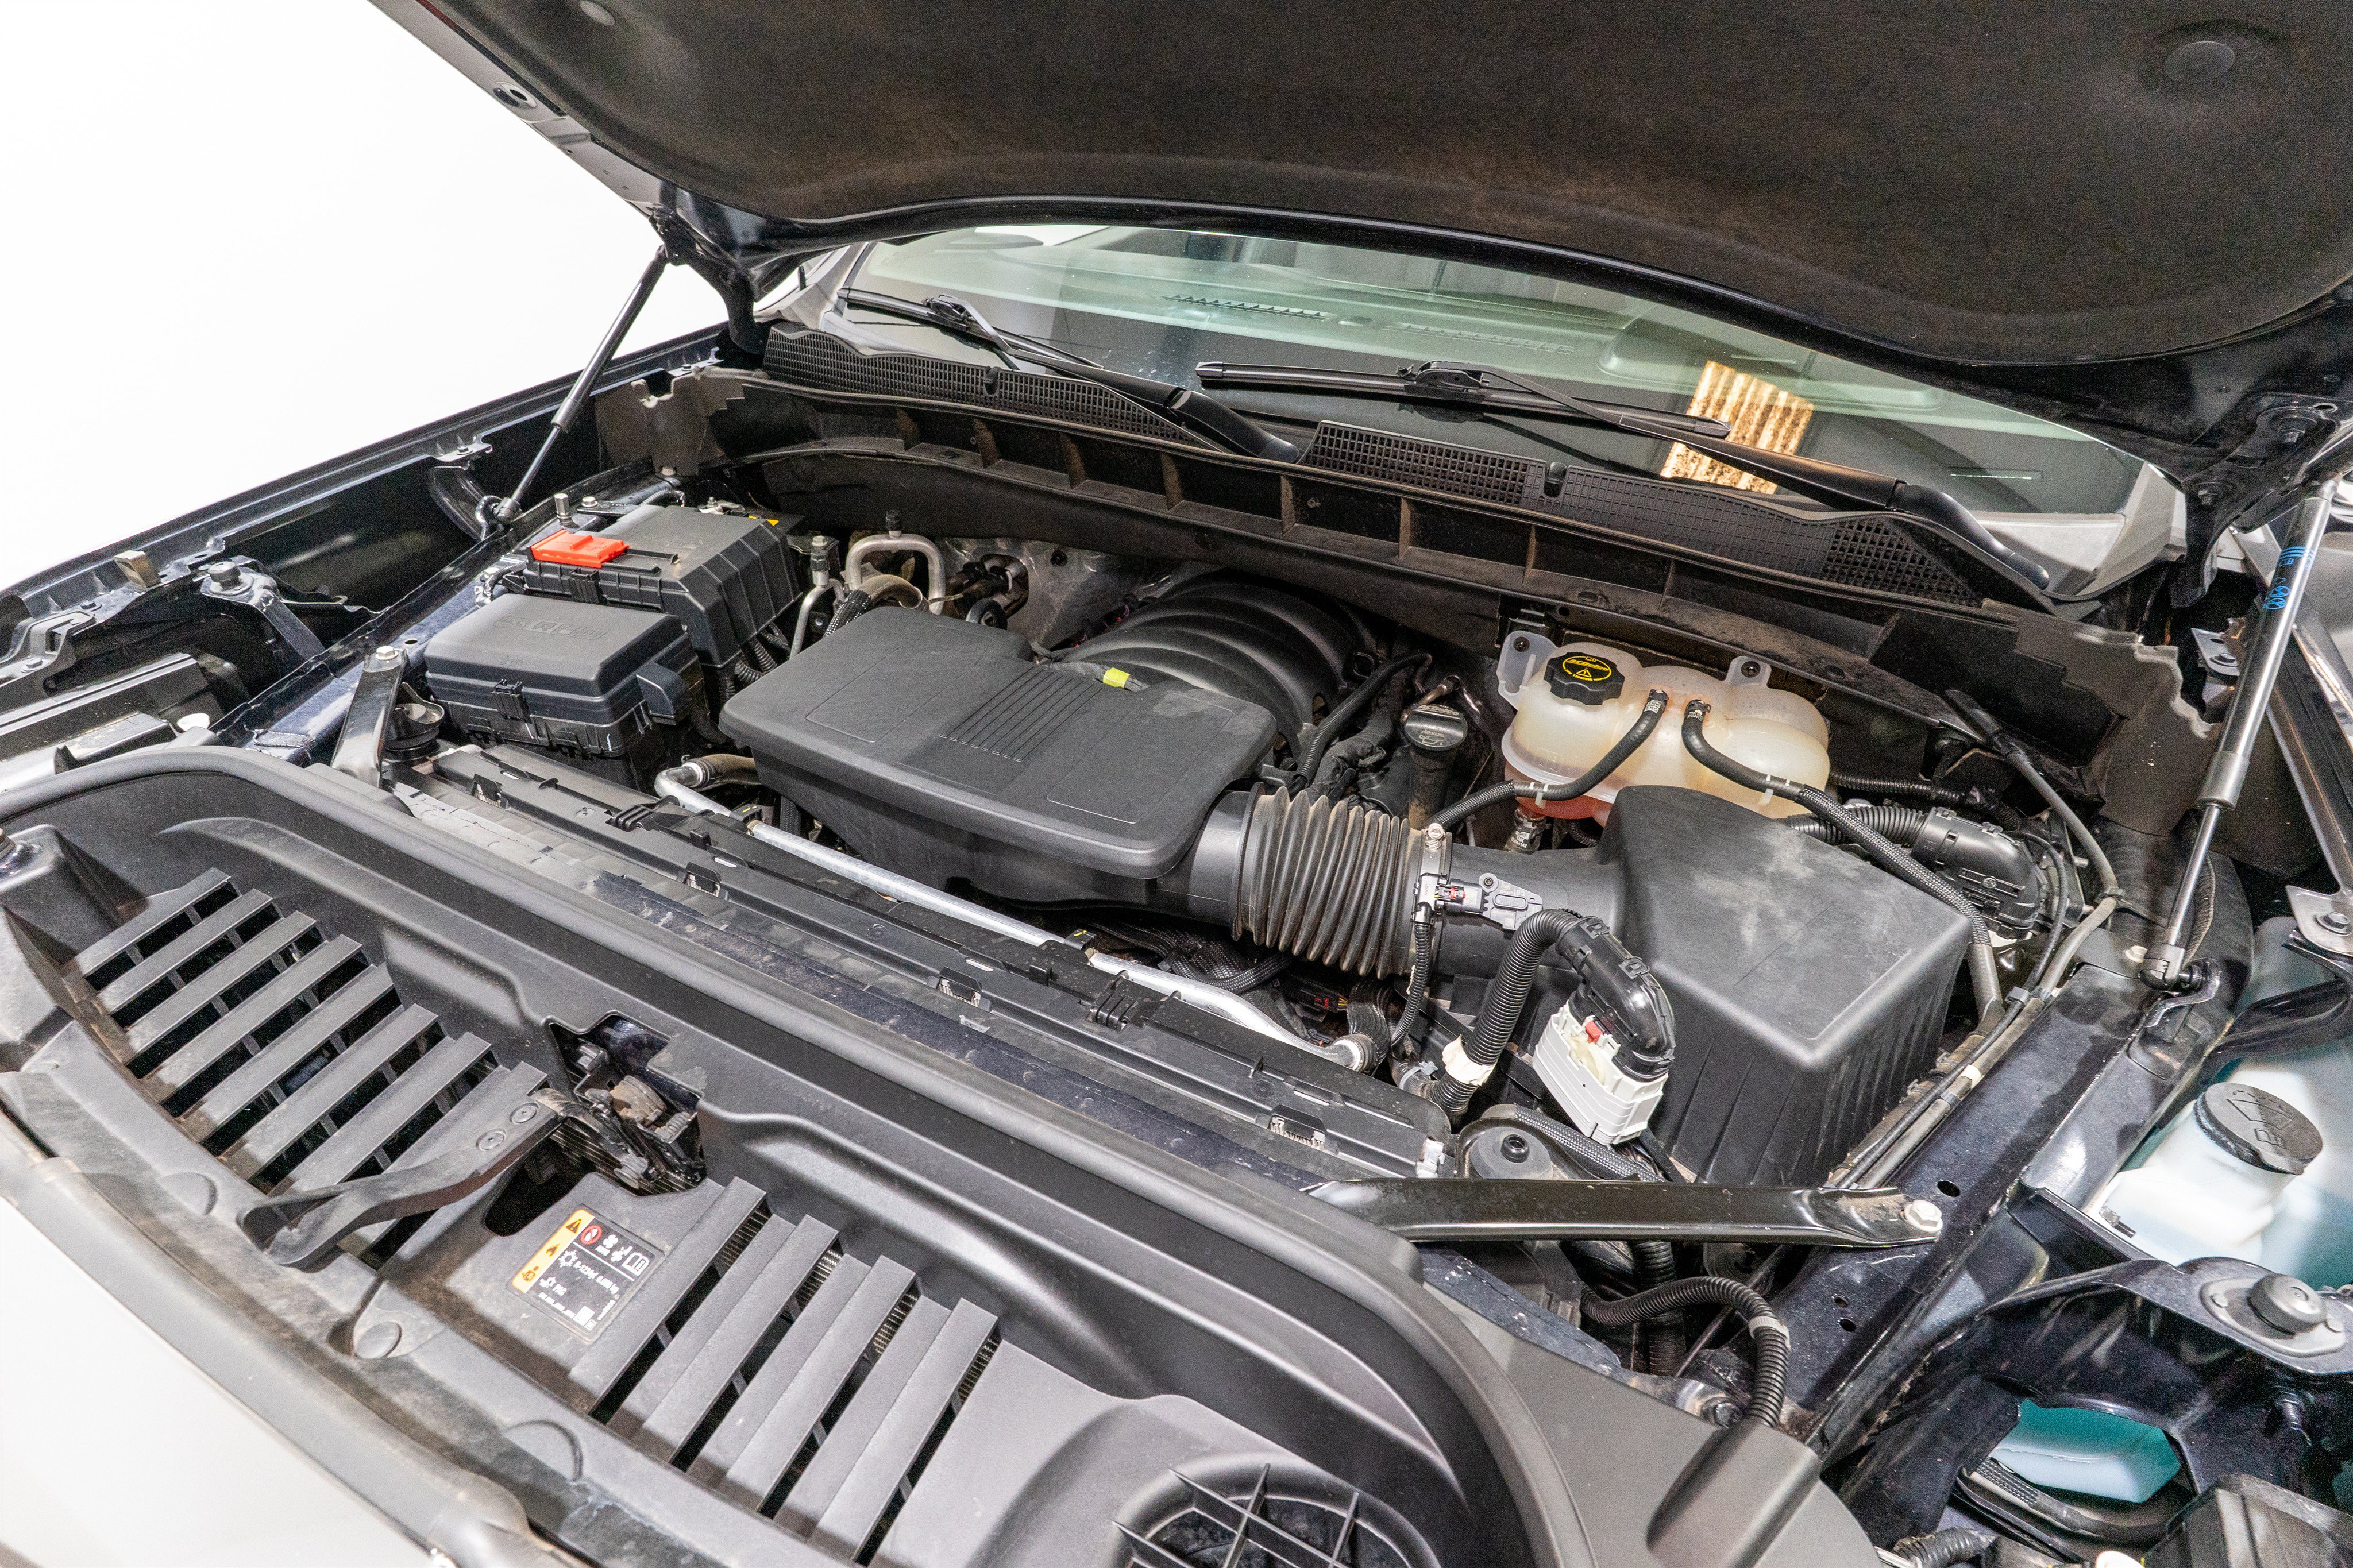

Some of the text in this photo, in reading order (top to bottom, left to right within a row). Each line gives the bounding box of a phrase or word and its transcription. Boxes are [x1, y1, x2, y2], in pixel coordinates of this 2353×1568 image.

[1566, 659, 1610, 671] ACDelco
[1421, 729, 1445, 737] dexos
[552, 1284, 567, 1296] PAG
